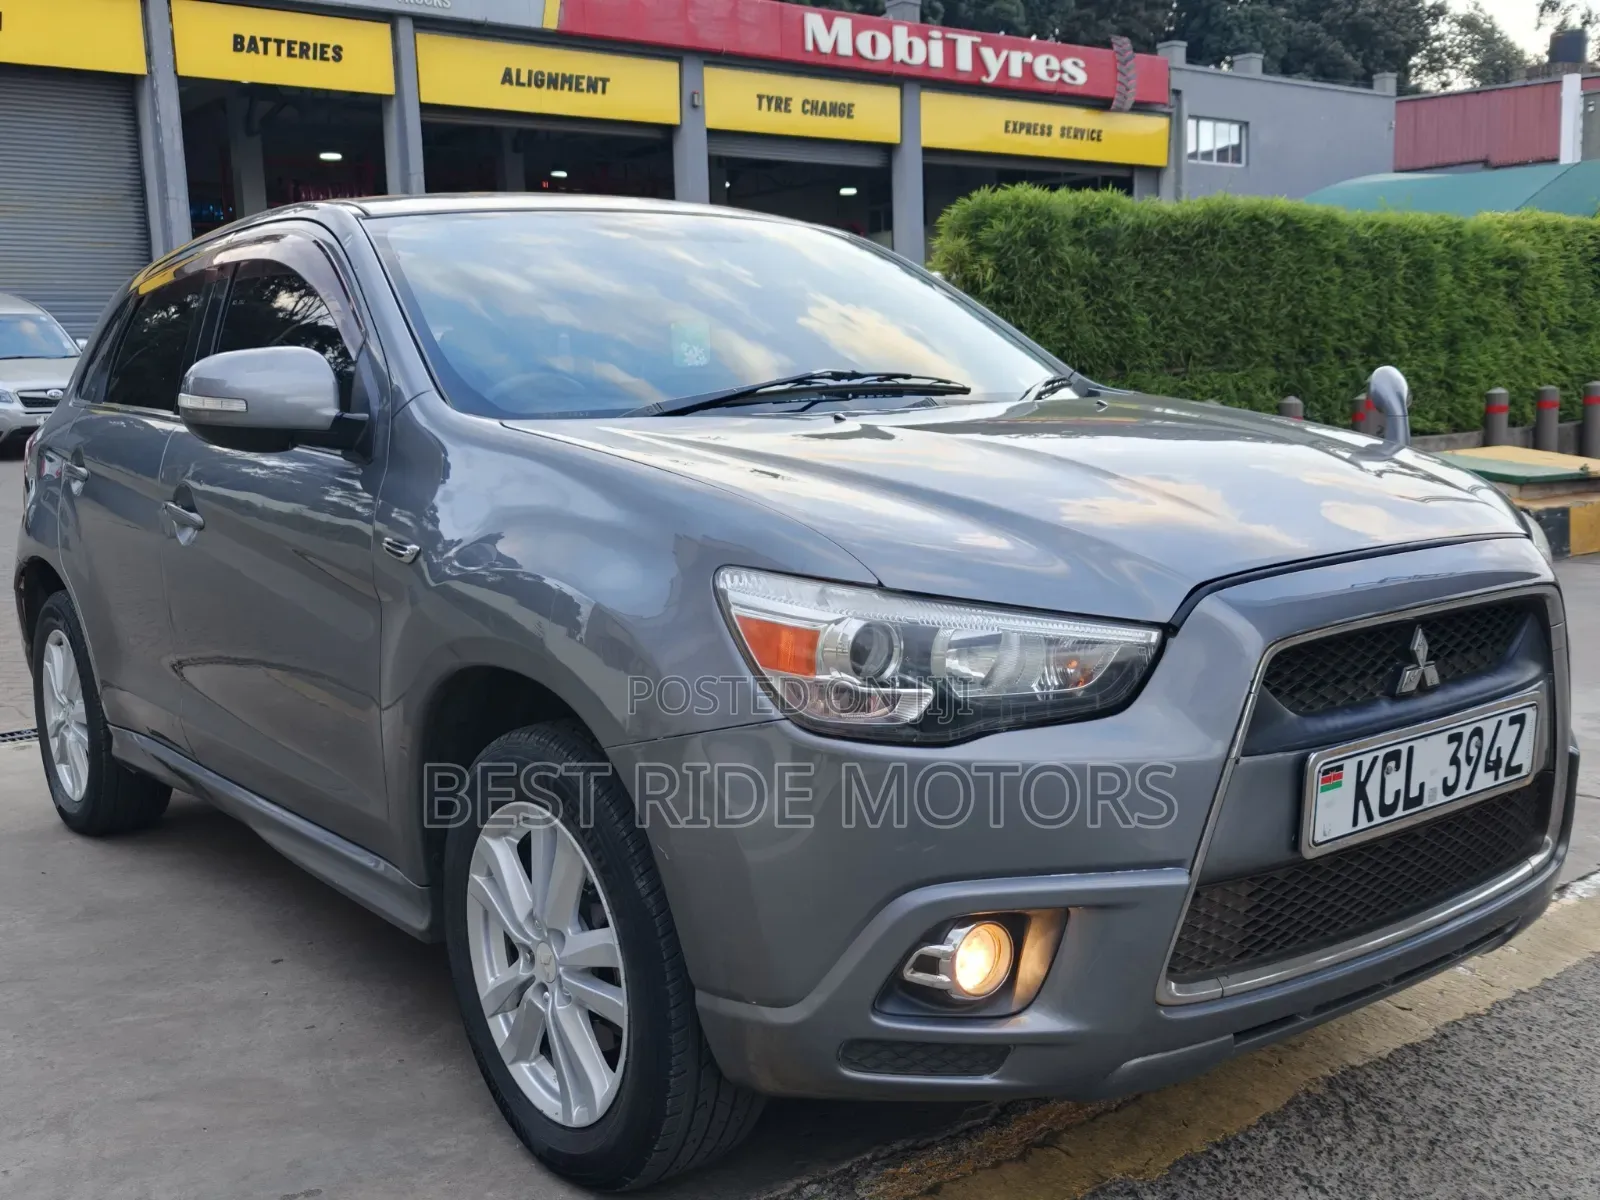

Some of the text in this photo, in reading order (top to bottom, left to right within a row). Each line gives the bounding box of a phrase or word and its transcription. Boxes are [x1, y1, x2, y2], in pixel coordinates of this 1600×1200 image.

[232, 33, 344, 63] BATTERIES
[804, 12, 1088, 84] MobiTyres
[500, 67, 610, 95] ALIGNMENT
[756, 94, 855, 119] TYRE CHANGE
[1004, 120, 1103, 143] EXPRESS SERVICE
[1352, 712, 1527, 828] KCL 394Z
